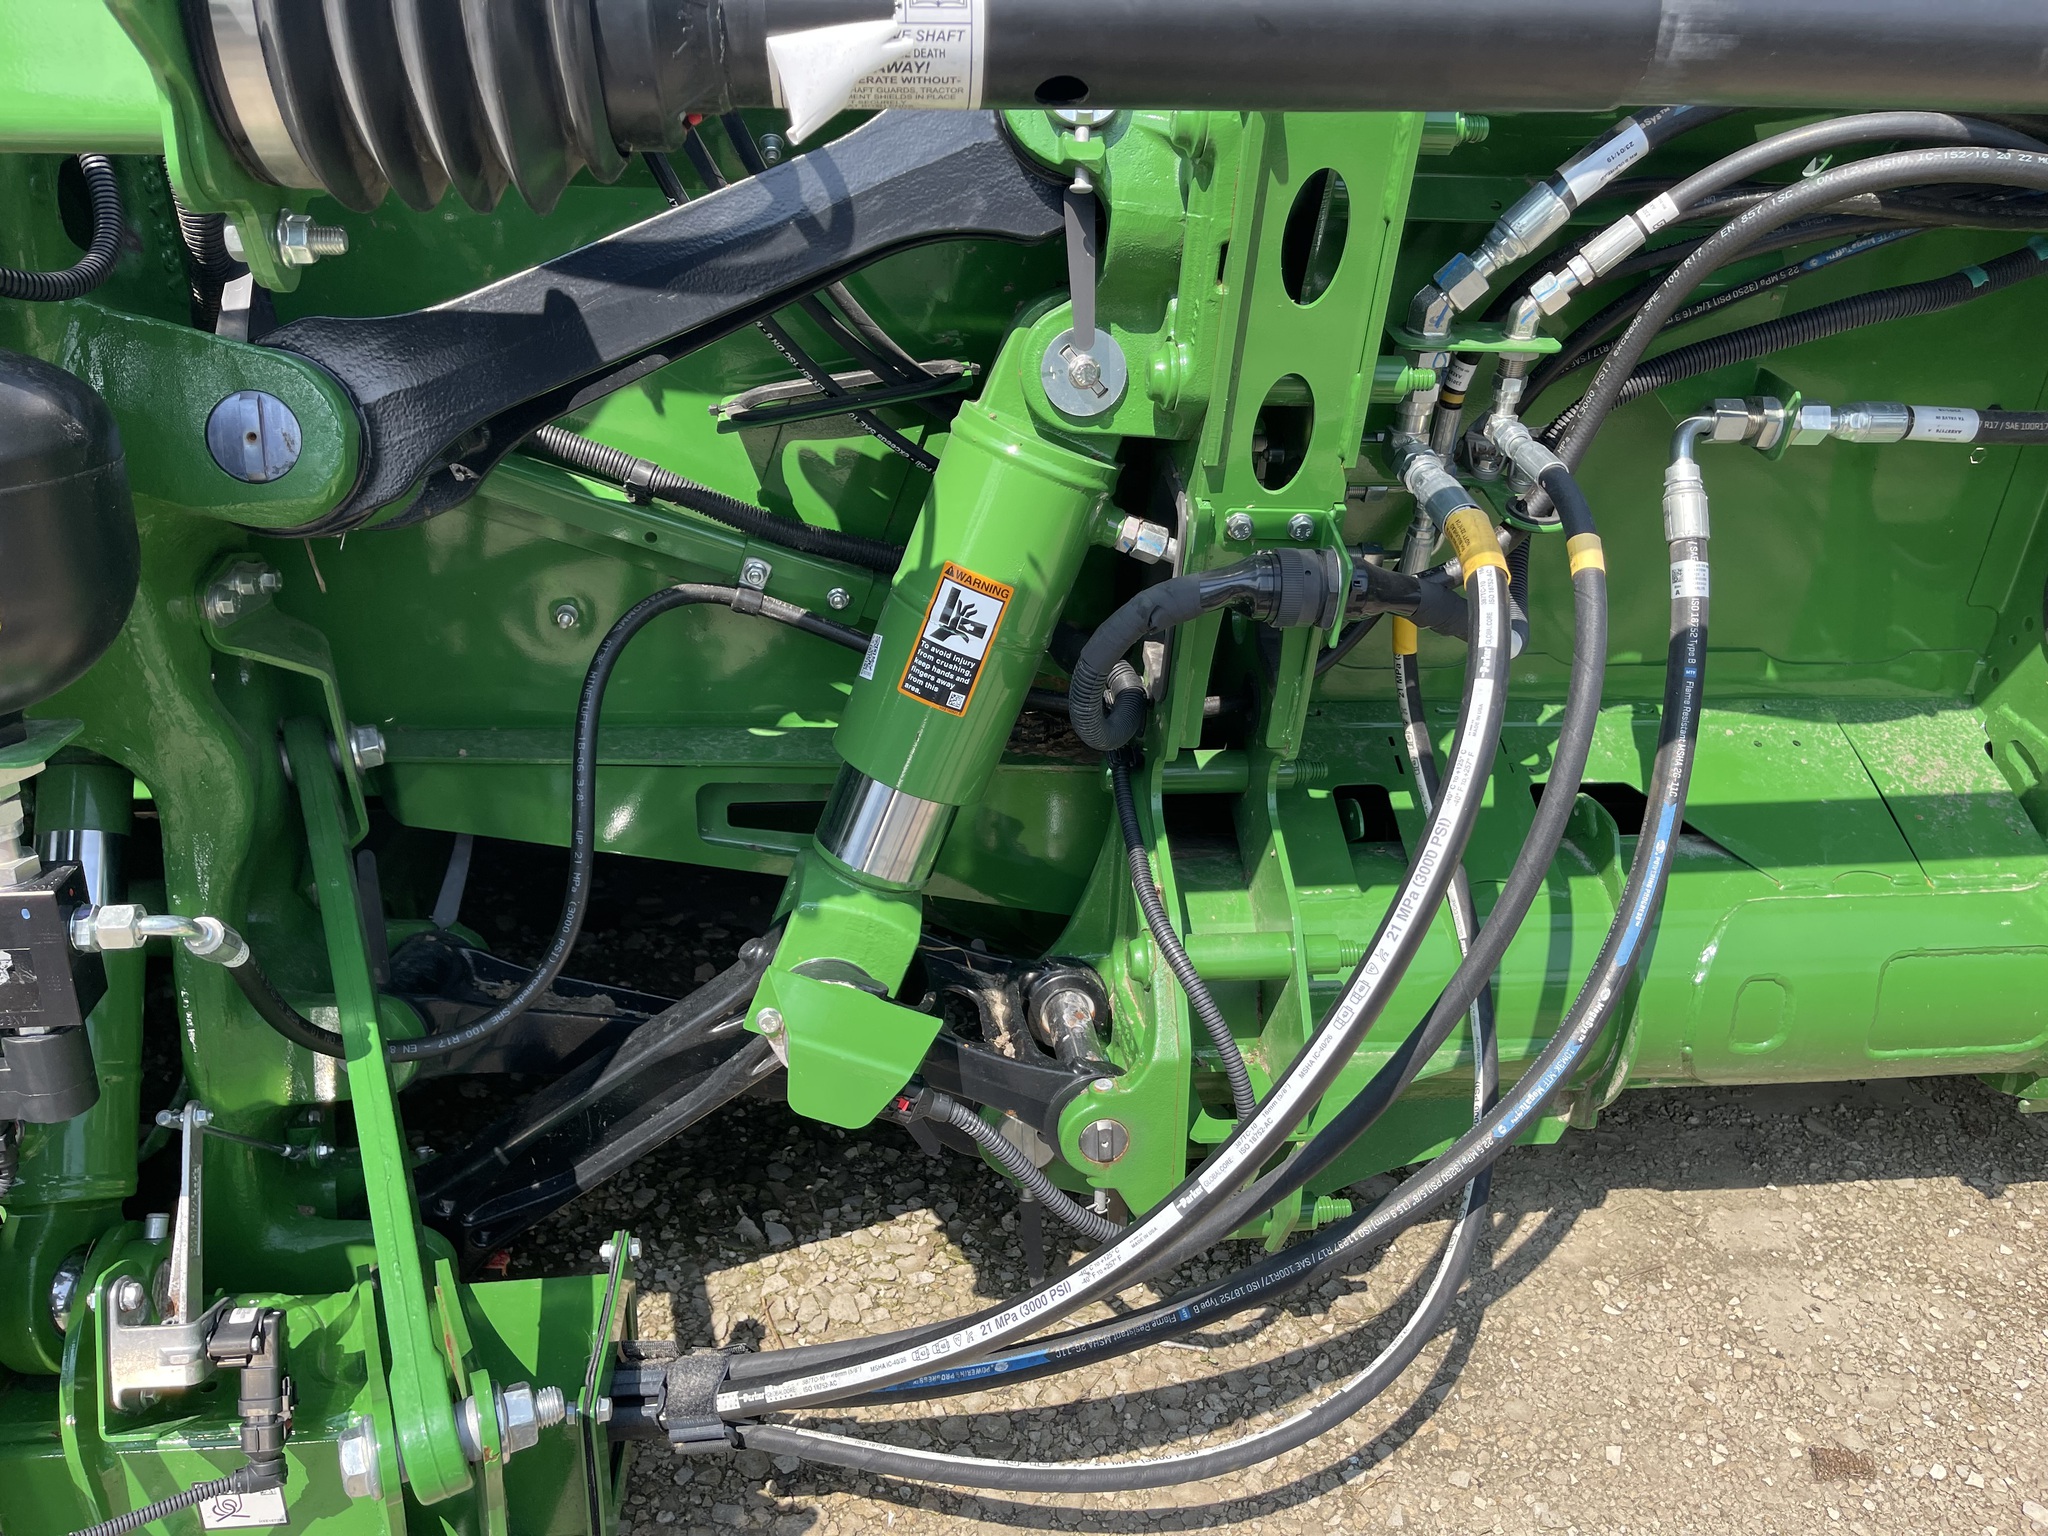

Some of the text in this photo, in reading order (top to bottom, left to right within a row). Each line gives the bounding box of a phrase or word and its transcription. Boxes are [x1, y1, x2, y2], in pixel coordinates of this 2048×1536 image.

[916, 29, 966, 42] SHAFT
[913, 48, 946, 59] DEATH
[858, 76, 898, 84] ERATE
[1730, 280, 1760, 298] (3250
[1758, 273, 1779, 288] MPa
[1556, 435, 1571, 455] MPa
[1575, 389, 1596, 419] (3000
[1593, 359, 1612, 387] PSI)
[1610, 313, 1644, 357] exceeds
[1642, 289, 1662, 312] SAE
[1661, 268, 1682, 288] 100
[1681, 246, 1705, 268] R17
[1718, 221, 1736, 238] EN
[1739, 203, 1765, 224] 857
[1815, 173, 1834, 185] DN
[1842, 165, 1859, 176] 12
[1996, 151, 2011, 160] 20
[2017, 153, 2032, 162] 22
[1711, 291, 1732, 305] PSI)
[770, 337, 785, 352] DN
[1984, 420, 1998, 429] R17
[2005, 420, 2019, 430] SAE
[956, 569, 1010, 599] WARNING
[1690, 597, 1698, 610] ISO
[1689, 611, 1698, 638] 18752
[1479, 611, 1493, 673] Parker GLOBALCORE
[1687, 638, 1697, 658] Type
[917, 649, 972, 677] from crushing,
[921, 640, 976, 669] To avoid injury
[911, 665, 955, 690] fingers away
[914, 656, 970, 685] keep hands and
[904, 682, 921, 695] area.
[907, 674, 939, 692] from this
[1394, 662, 1404, 699] 21 MPa
[1683, 680, 1695, 706] Flame
[574, 669, 599, 771] MINETUFF-1B-06
[1471, 719, 1480, 737] MADE
[1677, 706, 1691, 743] Resistant
[1674, 742, 1685, 766] MSHA
[1454, 755, 1465, 775] +125°
[1461, 757, 1473, 777] +257°
[576, 778, 584, 807] 3/8"
[573, 851, 582, 864] 21
[570, 871, 580, 893] MPa
[1384, 815, 1452, 942] 21 MPa (3000 PSI)
[559, 900, 577, 934] (3000
[547, 937, 565, 964] PSI)
[1459, 938, 1468, 956] rker
[511, 965, 547, 1008] exceeds
[489, 1006, 511, 1025] SAE
[464, 1023, 485, 1038] 100
[402, 1043, 418, 1053] EN
[436, 1034, 460, 1048] R17
[1297, 1032, 1333, 1079] MSHA IC-40/26
[1233, 1082, 1292, 1149] 387TC-10 16mm (5/8")
[1238, 1116, 1274, 1155] ISO 18752-AC
[1475, 1135, 1495, 1154] 22.5
[1459, 1148, 1479, 1167] MPa
[1439, 1160, 1464, 1184] (3250
[1177, 1157, 1234, 1209] Parker GLOBALCORE
[1422, 1176, 1443, 1195] PSI)
[1407, 1188, 1427, 1207] 5/8"
[1387, 1199, 1411, 1220] (15.9
[1370, 1212, 1392, 1230] mm)
[1129, 1226, 1158, 1249] MADE USA
[1356, 1224, 1373, 1238] ISO
[1116, 1254, 1123, 1262] F
[1314, 1246, 1333, 1261] R17
[1294, 1256, 1312, 1271] SAE
[1217, 1286, 1246, 1304] 18752
[1244, 1280, 1260, 1293] ISO
[978, 1278, 1074, 1336] 21 MPa (3000 PSI)
[1192, 1304, 1199, 1314] B
[1198, 1296, 1219, 1311] Type
[1149, 1313, 1176, 1329] Flame
[1086, 1334, 1112, 1349] MSHA
[1111, 1321, 1150, 1343] Resistant
[869, 1362, 886, 1372] MSHA
[742, 1390, 765, 1402] Parker
[802, 1384, 813, 1393] ISO
